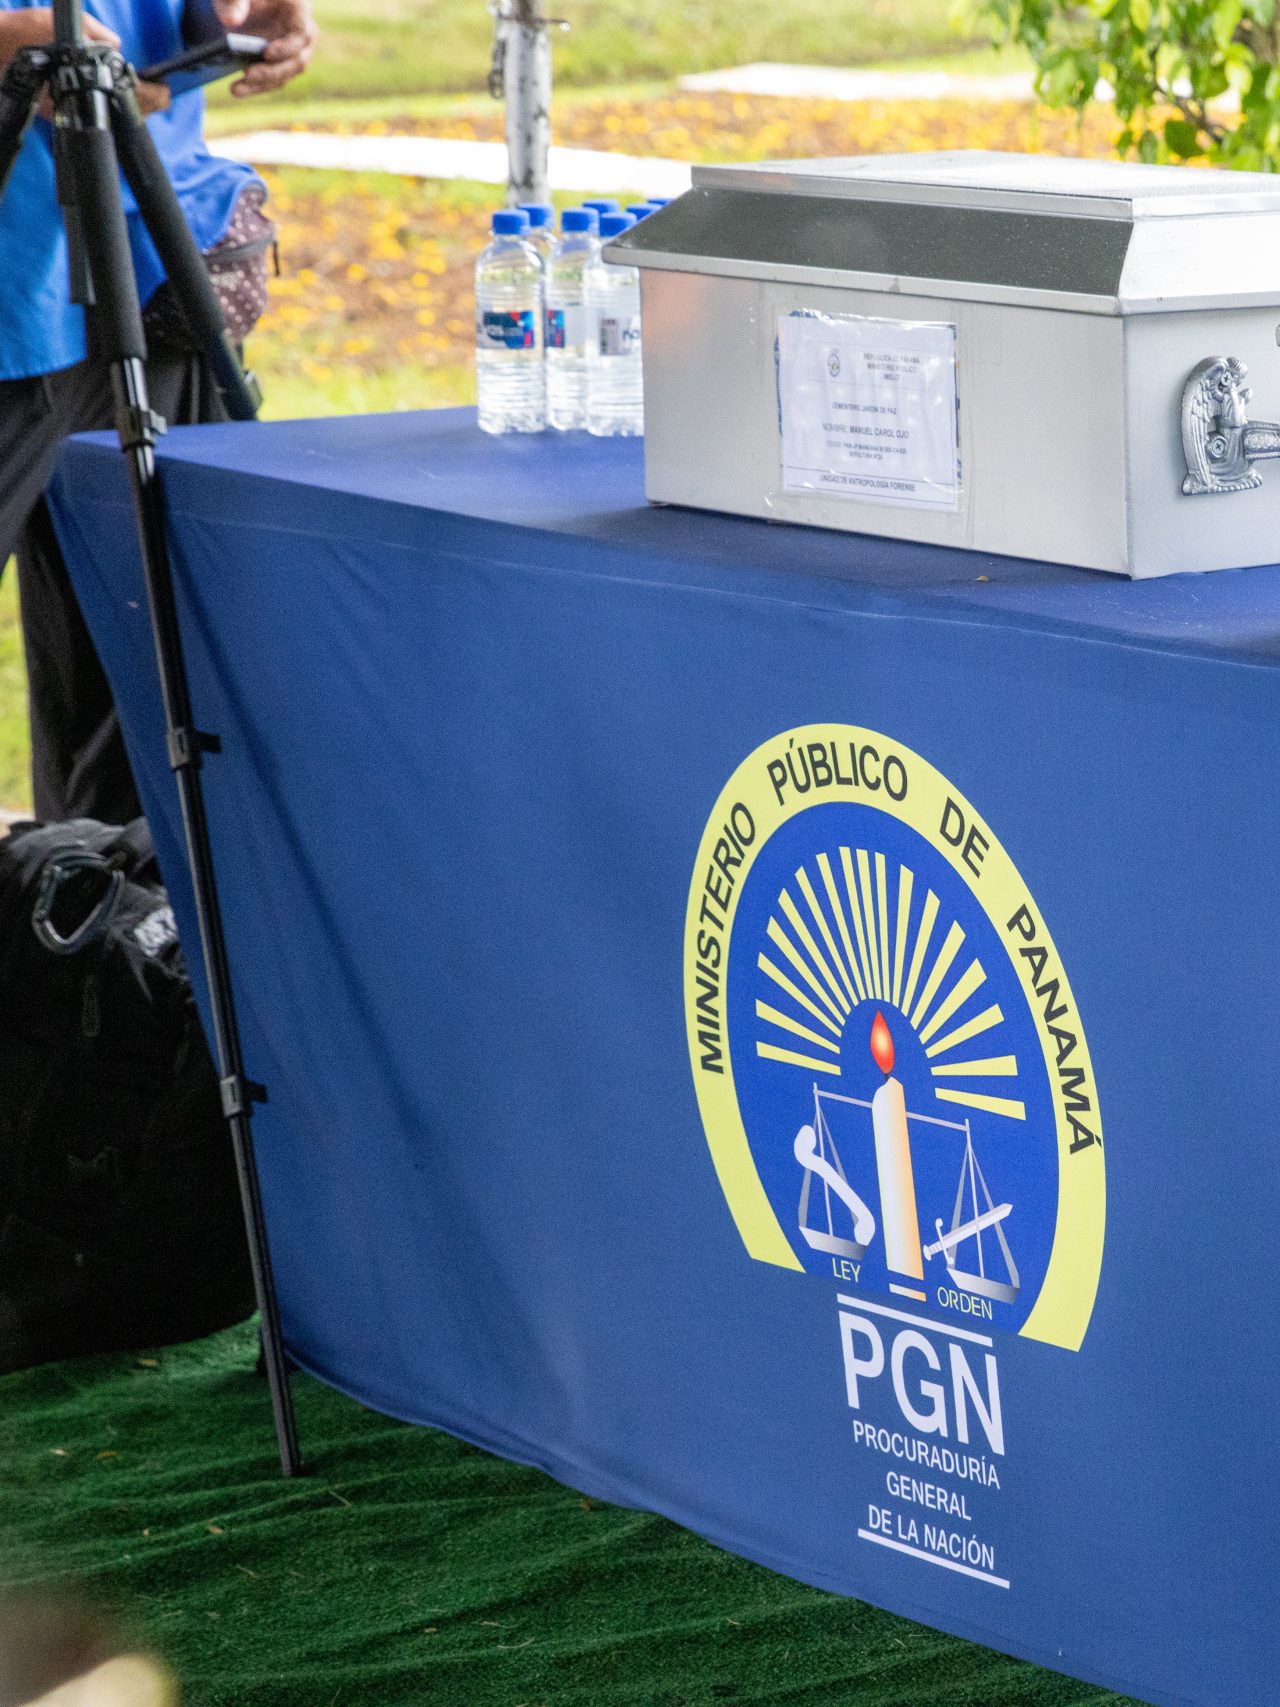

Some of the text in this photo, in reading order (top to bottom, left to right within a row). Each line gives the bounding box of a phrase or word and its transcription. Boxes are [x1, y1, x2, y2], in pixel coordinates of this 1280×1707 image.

[850, 425, 873, 436] MANUEL
[890, 481, 916, 492] FORENSE
[695, 737, 1103, 1156] MINISTERIO PÚBLICO DE PANAMÁ
[831, 1257, 861, 1283] LEY
[936, 1285, 993, 1321] ORDEN
[838, 1310, 1005, 1456] PGN
[852, 1418, 1001, 1490] PROCURADURÍA
[886, 1470, 972, 1521] GENERAL
[868, 1504, 995, 1570] DE LA NACIÓN
